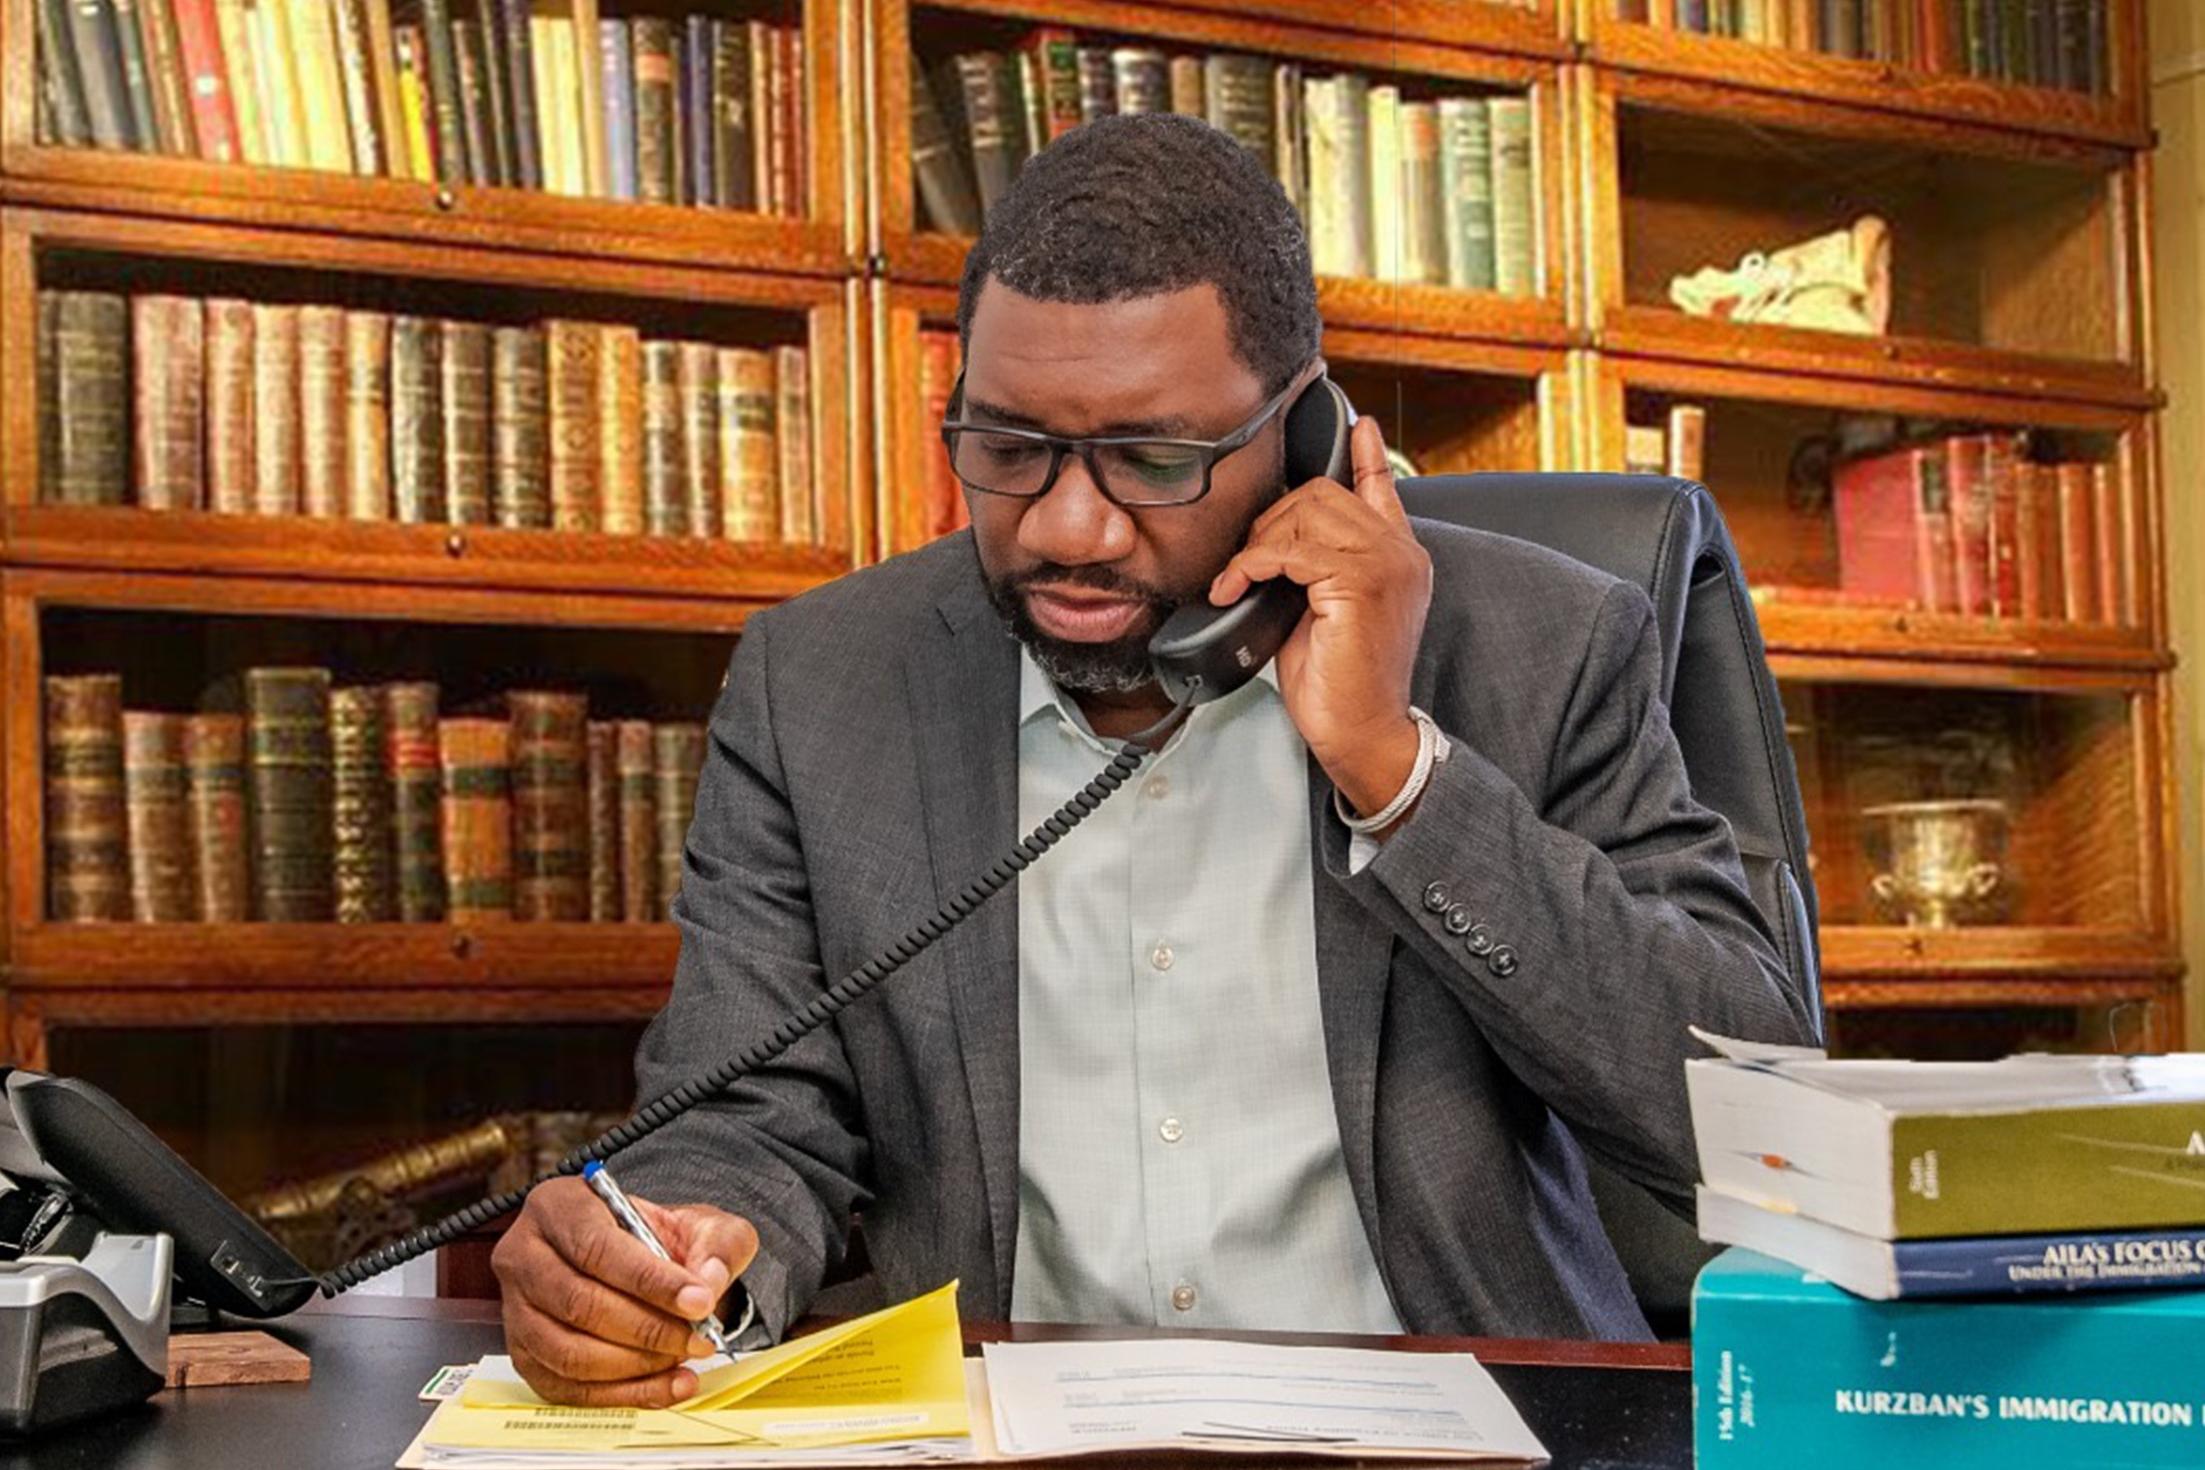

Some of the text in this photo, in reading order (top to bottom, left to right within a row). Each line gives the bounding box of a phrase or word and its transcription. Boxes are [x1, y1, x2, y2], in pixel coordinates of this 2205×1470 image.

[2114, 1240, 2193, 1264] FOCUS
[1718, 1350, 1734, 1404] Edition
[1835, 1389, 1990, 1419] KURZBAN'S
[1999, 1396, 2193, 1427] IMMIGRATION
